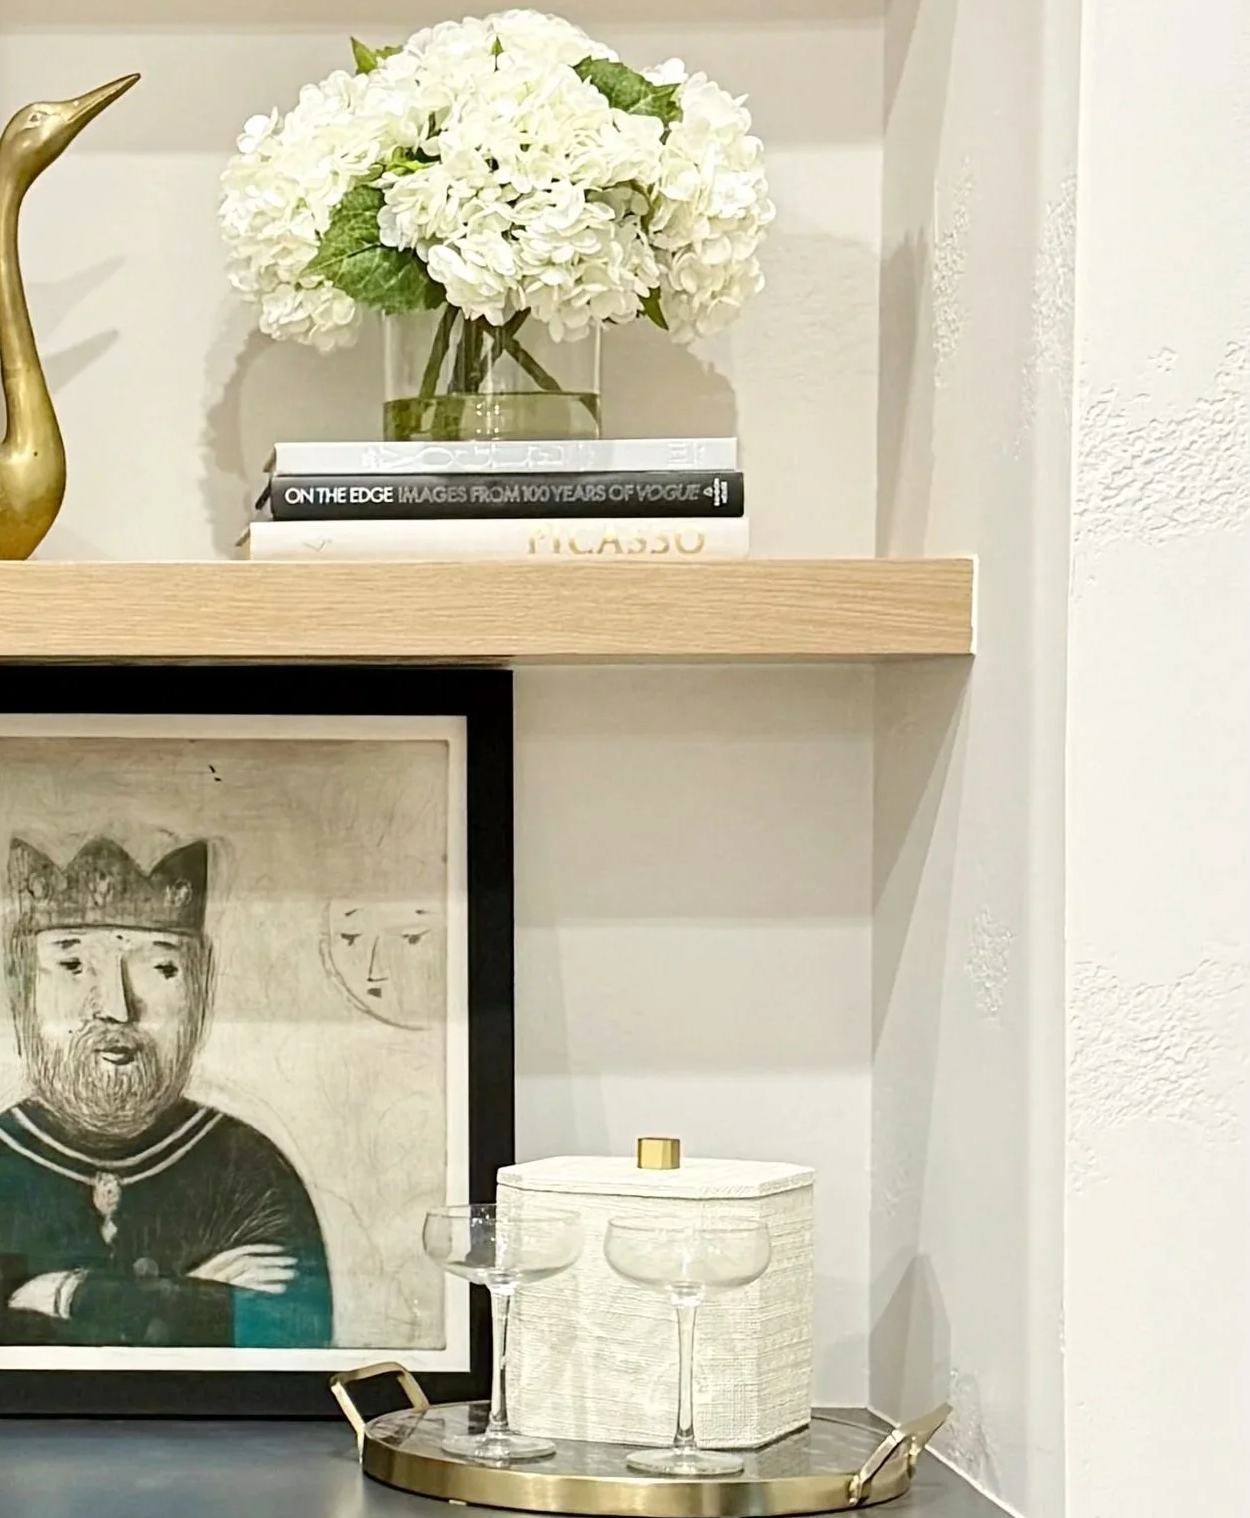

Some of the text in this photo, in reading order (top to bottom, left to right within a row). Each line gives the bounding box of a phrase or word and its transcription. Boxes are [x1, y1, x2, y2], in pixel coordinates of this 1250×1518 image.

[285, 487, 314, 504] ON
[316, 487, 347, 504] THE
[350, 486, 394, 503] EDGE
[398, 486, 467, 503] IMAGES
[470, 485, 520, 503] FROM
[521, 485, 550, 502] 100
[551, 484, 607, 502] YEARS
[608, 484, 636, 501] OF
[636, 483, 700, 501] VOGUE
[527, 524, 706, 555] PICASSO
